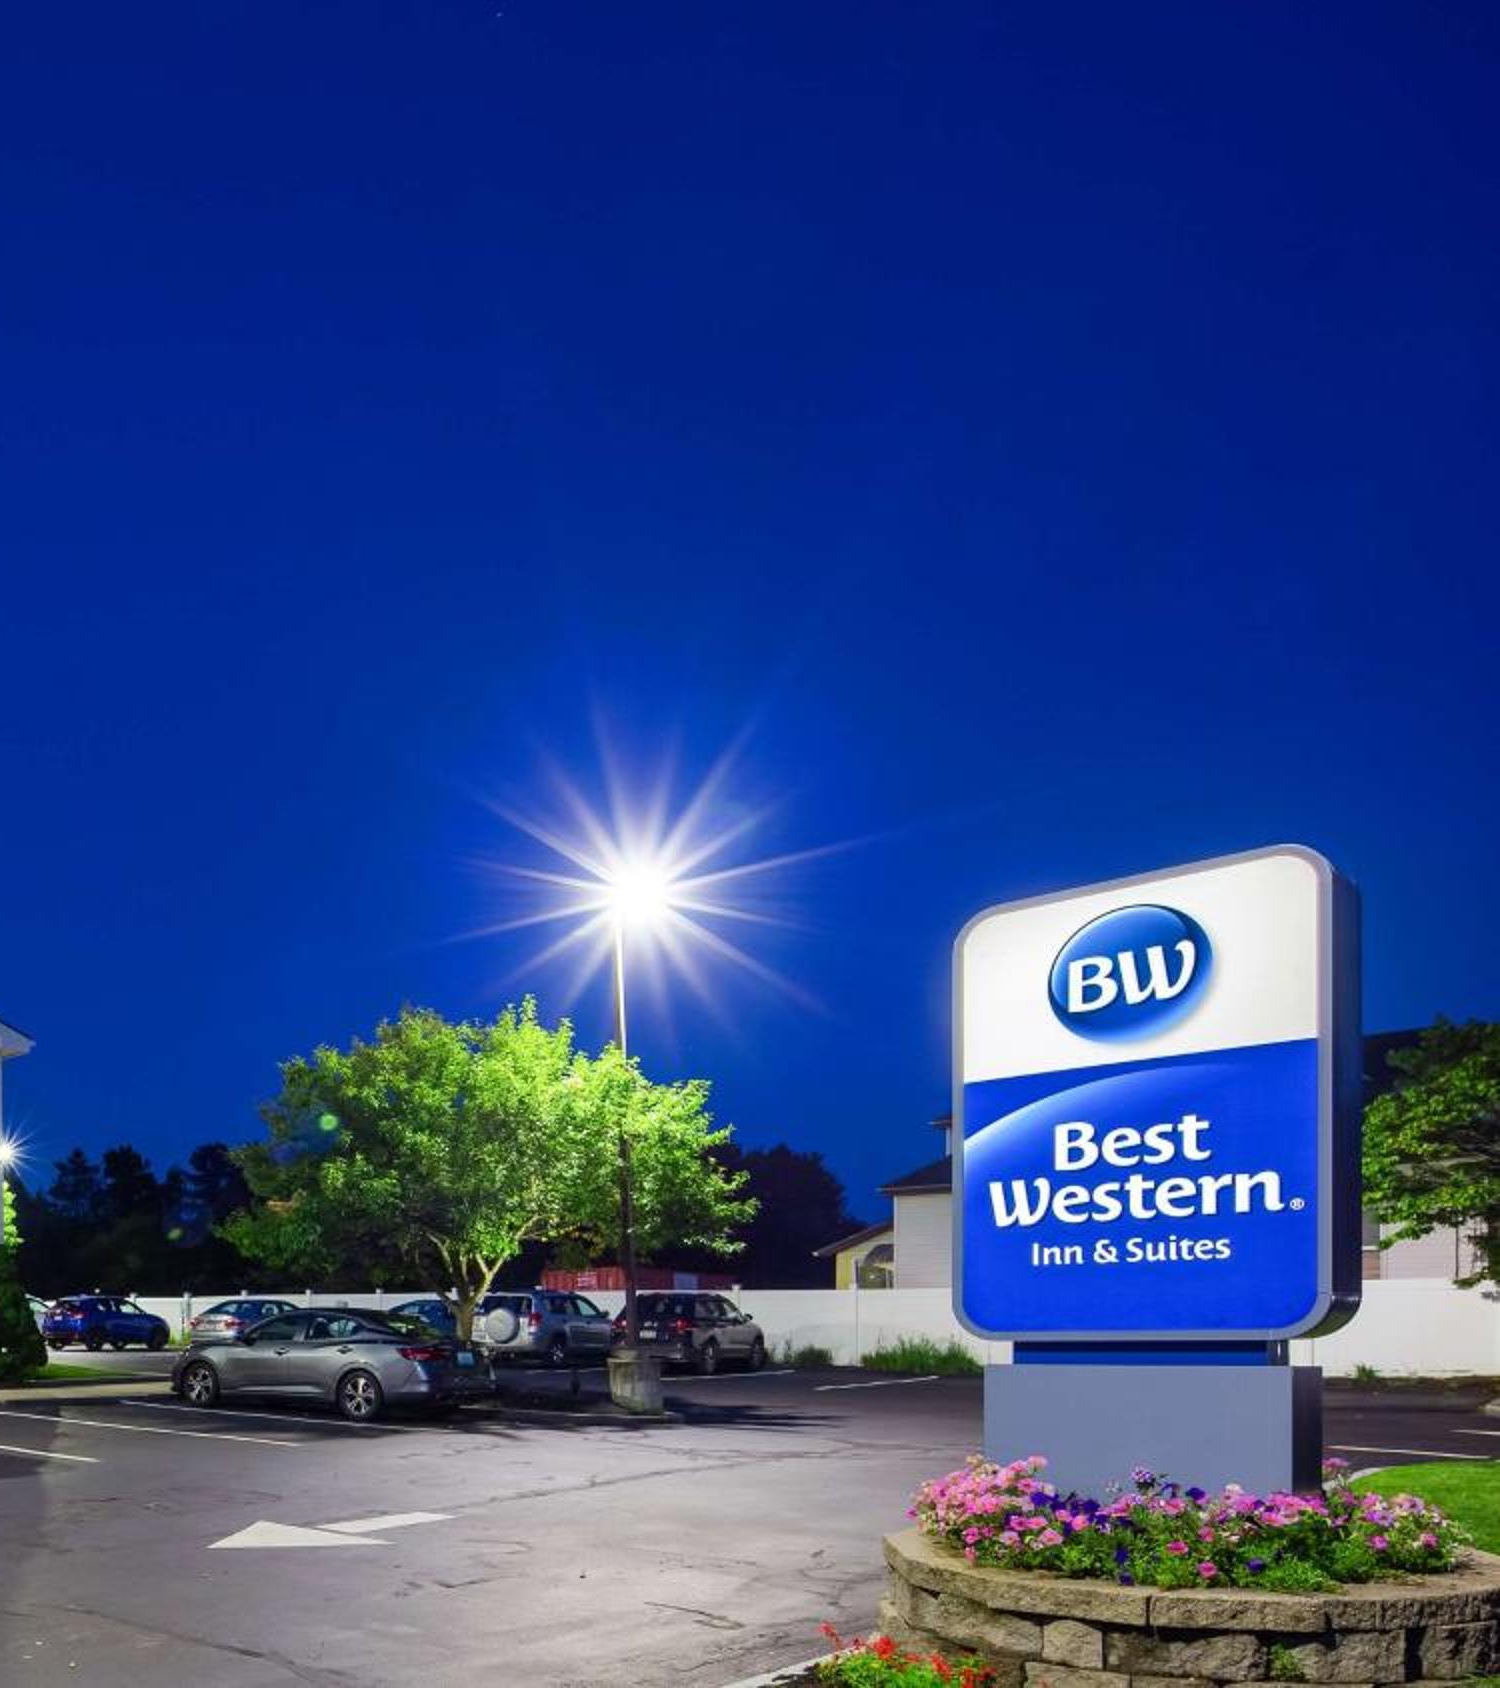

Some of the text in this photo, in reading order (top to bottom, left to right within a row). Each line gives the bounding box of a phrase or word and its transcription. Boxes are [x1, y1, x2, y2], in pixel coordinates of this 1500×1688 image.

[1067, 939, 1197, 1014] BW
[1053, 1114, 1212, 1171] Best
[989, 1171, 1285, 1228] Western
[1032, 1235, 1231, 1267] Inn & Suites
